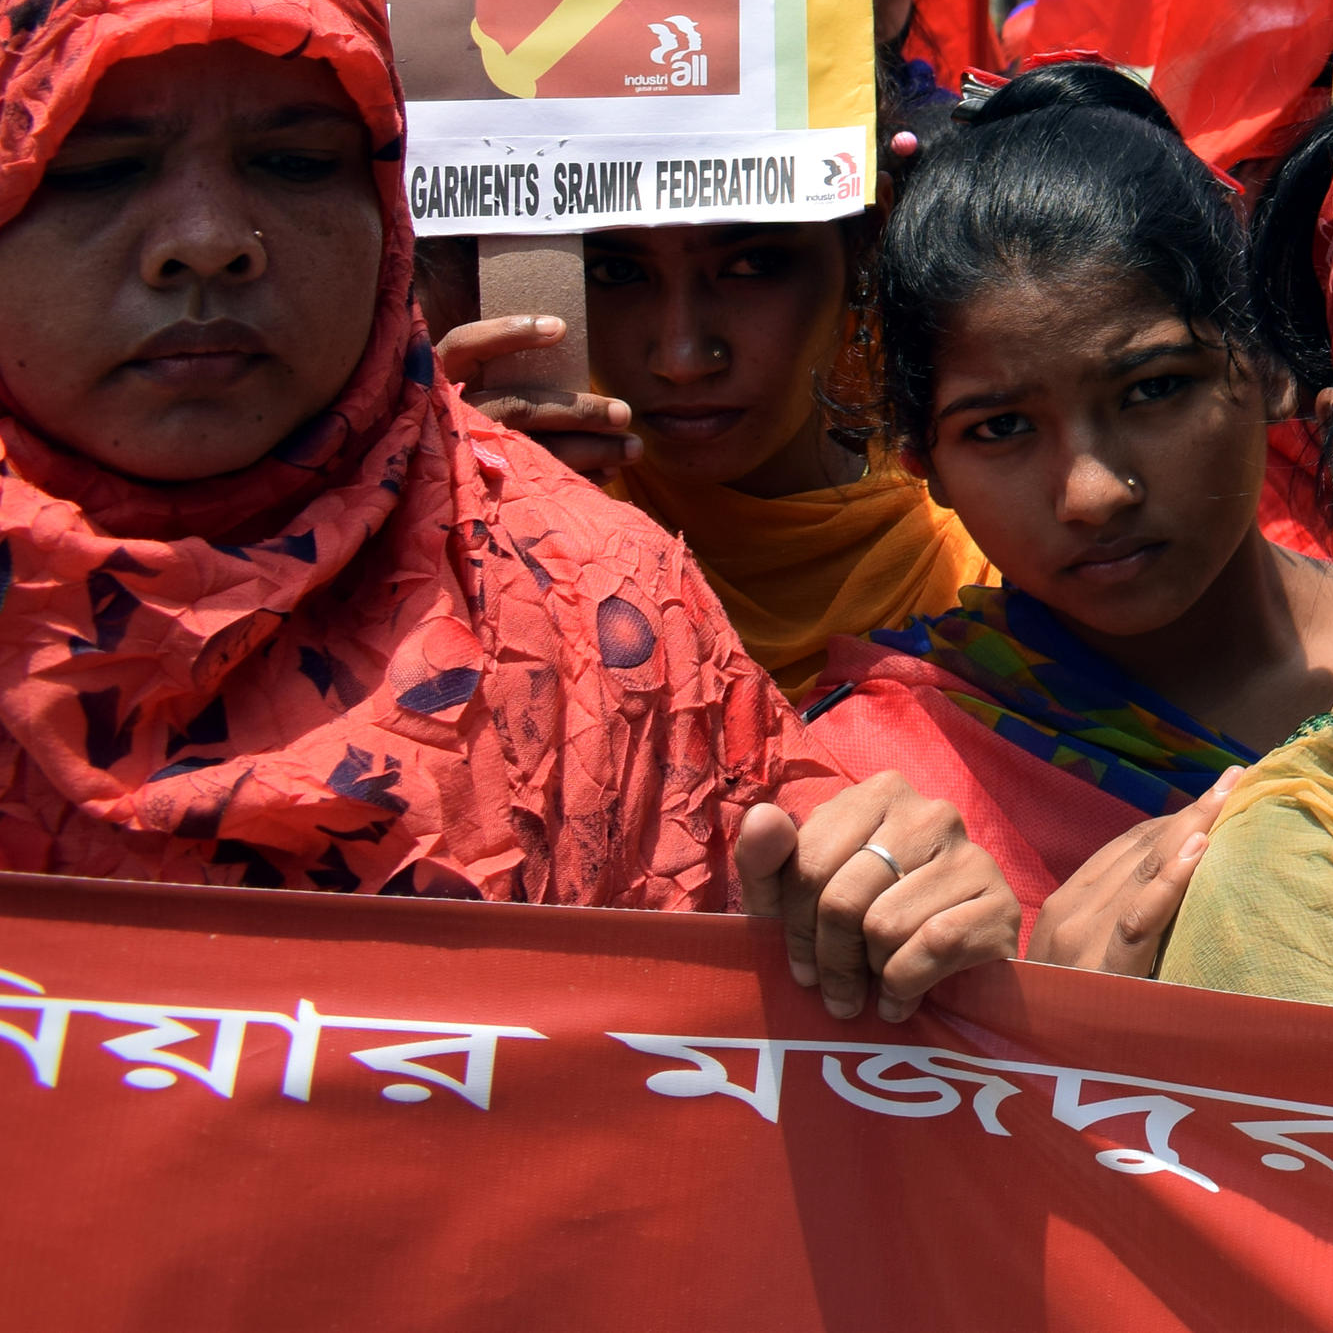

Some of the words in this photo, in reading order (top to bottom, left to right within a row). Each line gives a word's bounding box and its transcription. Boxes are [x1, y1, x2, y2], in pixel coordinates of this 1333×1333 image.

[411, 163, 539, 219] GARMENTS
[553, 161, 643, 215] SRAMIK
[656, 156, 795, 210] FEDERATION
